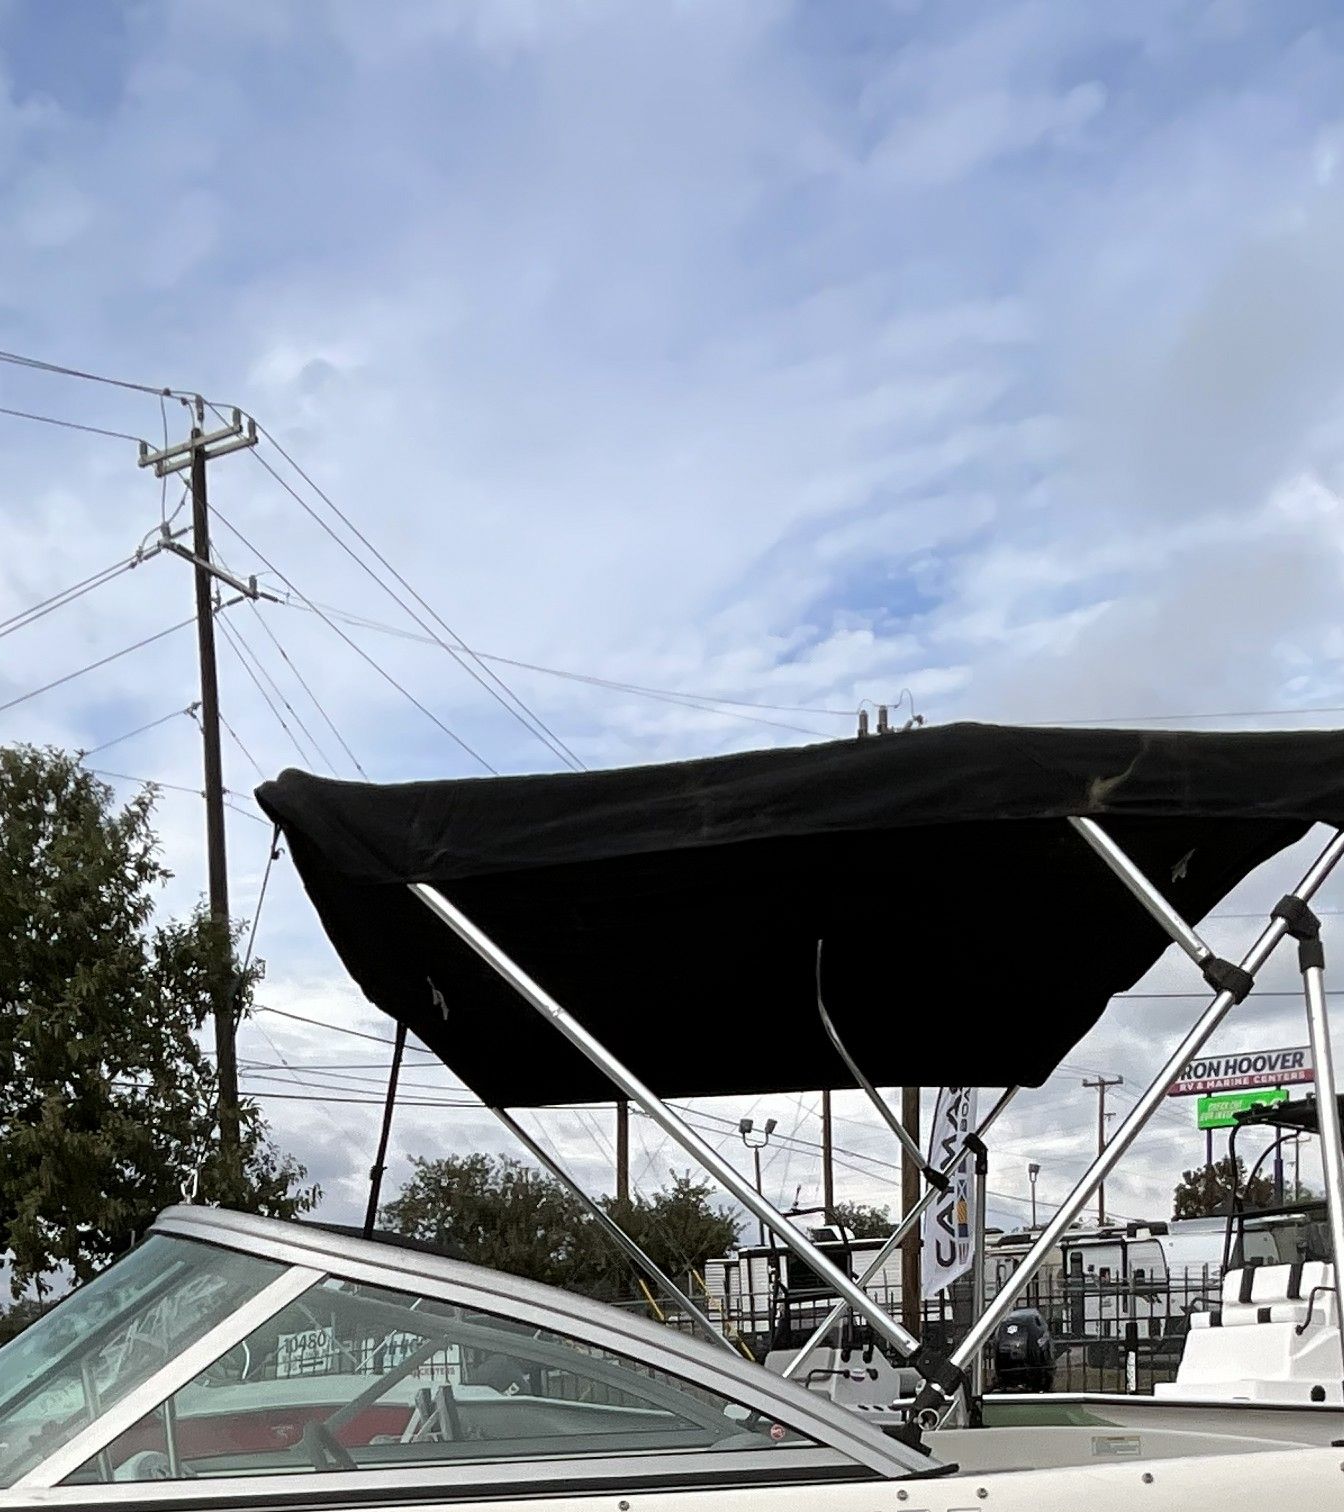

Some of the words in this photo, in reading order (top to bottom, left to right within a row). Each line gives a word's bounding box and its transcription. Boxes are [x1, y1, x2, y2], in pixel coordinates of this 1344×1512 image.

[1180, 1060, 1219, 1080] RON
[1223, 1051, 1305, 1076] HOOVER
[1179, 1081, 1195, 1091] RV
[1196, 1081, 1204, 1090] &
[1206, 1077, 1249, 1089] MARINE
[1253, 1071, 1306, 1084] CENTERS
